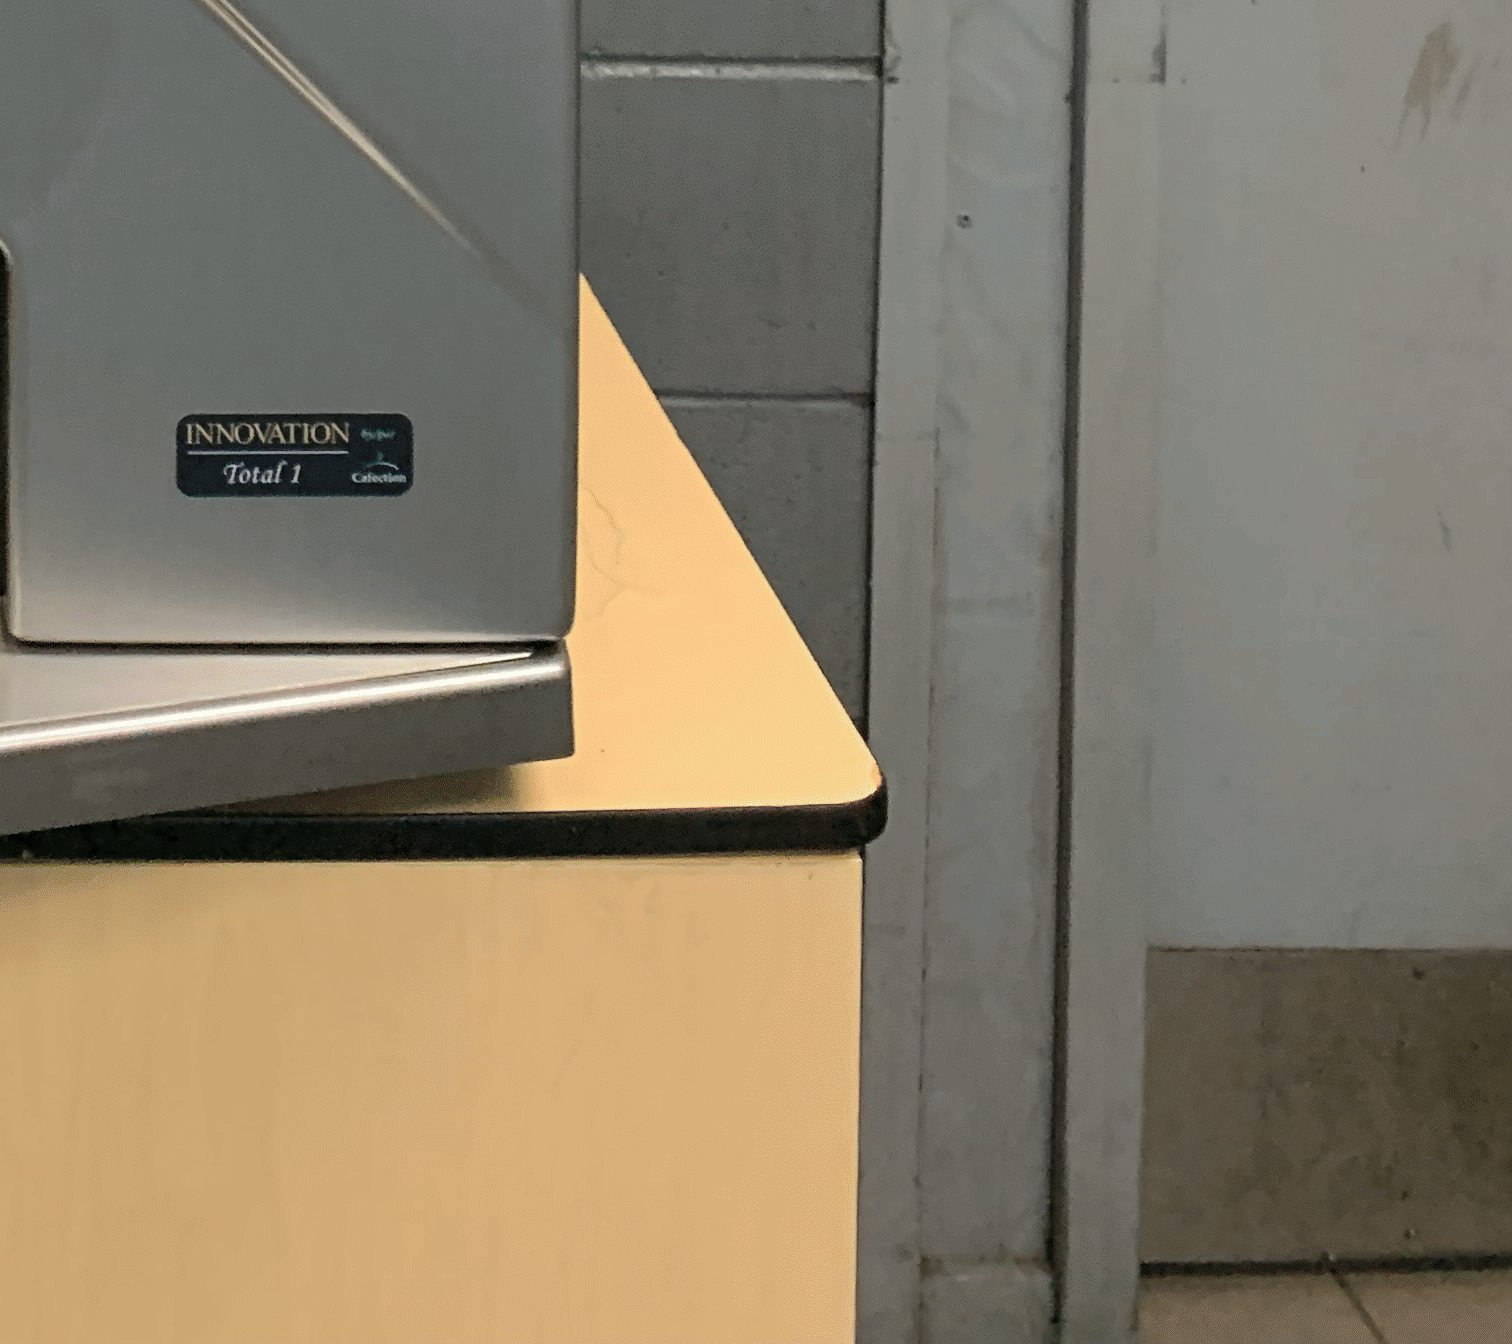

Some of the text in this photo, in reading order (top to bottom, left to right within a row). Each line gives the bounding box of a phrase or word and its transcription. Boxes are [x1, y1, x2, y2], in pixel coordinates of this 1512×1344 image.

[185, 421, 350, 446] INNOVATION
[223, 458, 302, 485] Total 1
